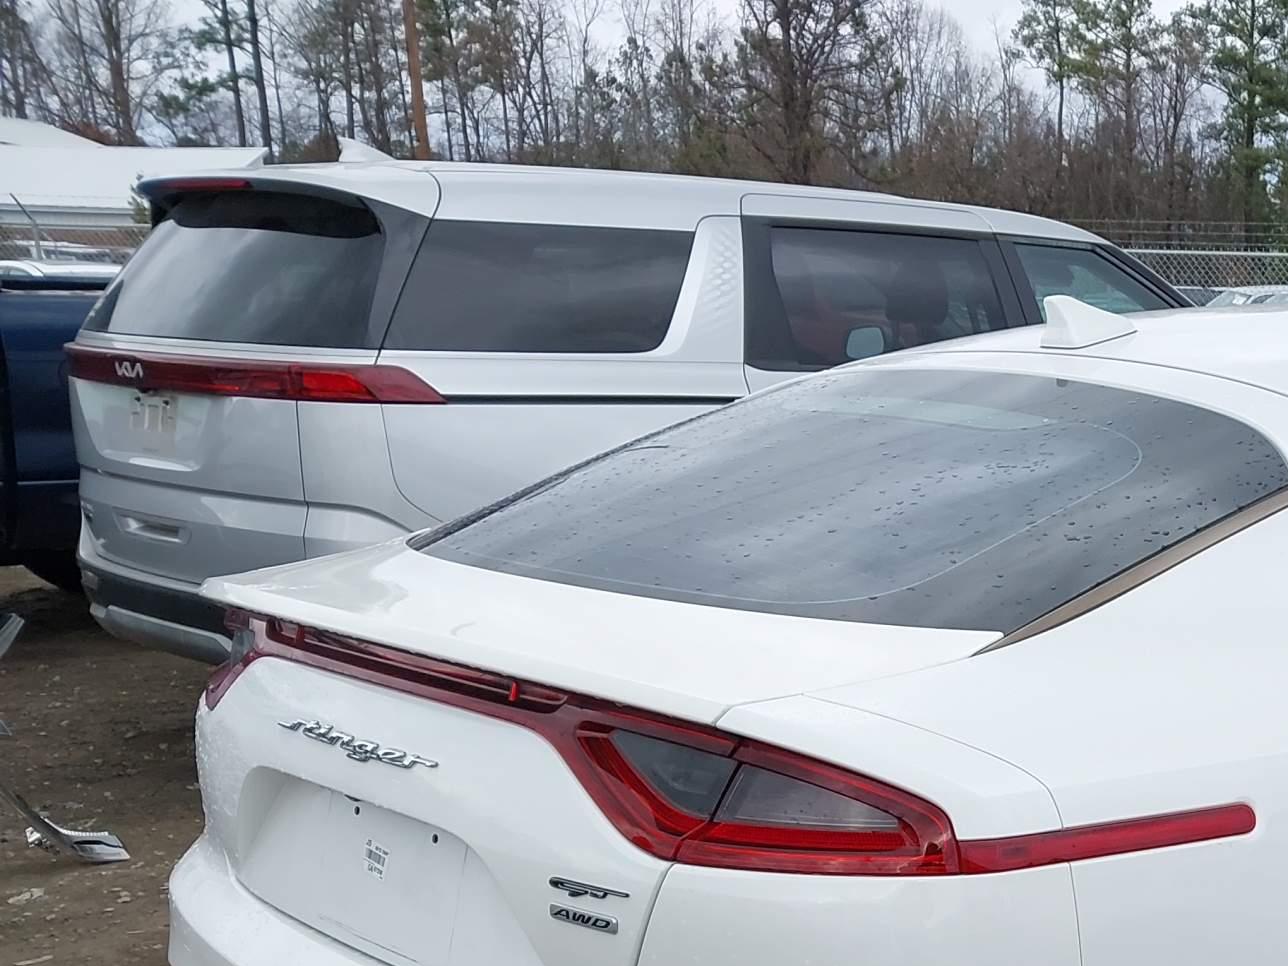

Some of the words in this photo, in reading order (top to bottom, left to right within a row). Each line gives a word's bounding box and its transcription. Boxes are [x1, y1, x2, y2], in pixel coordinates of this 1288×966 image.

[115, 361, 144, 378] KIA
[548, 876, 631, 899] GT
[553, 908, 612, 929] AWD
